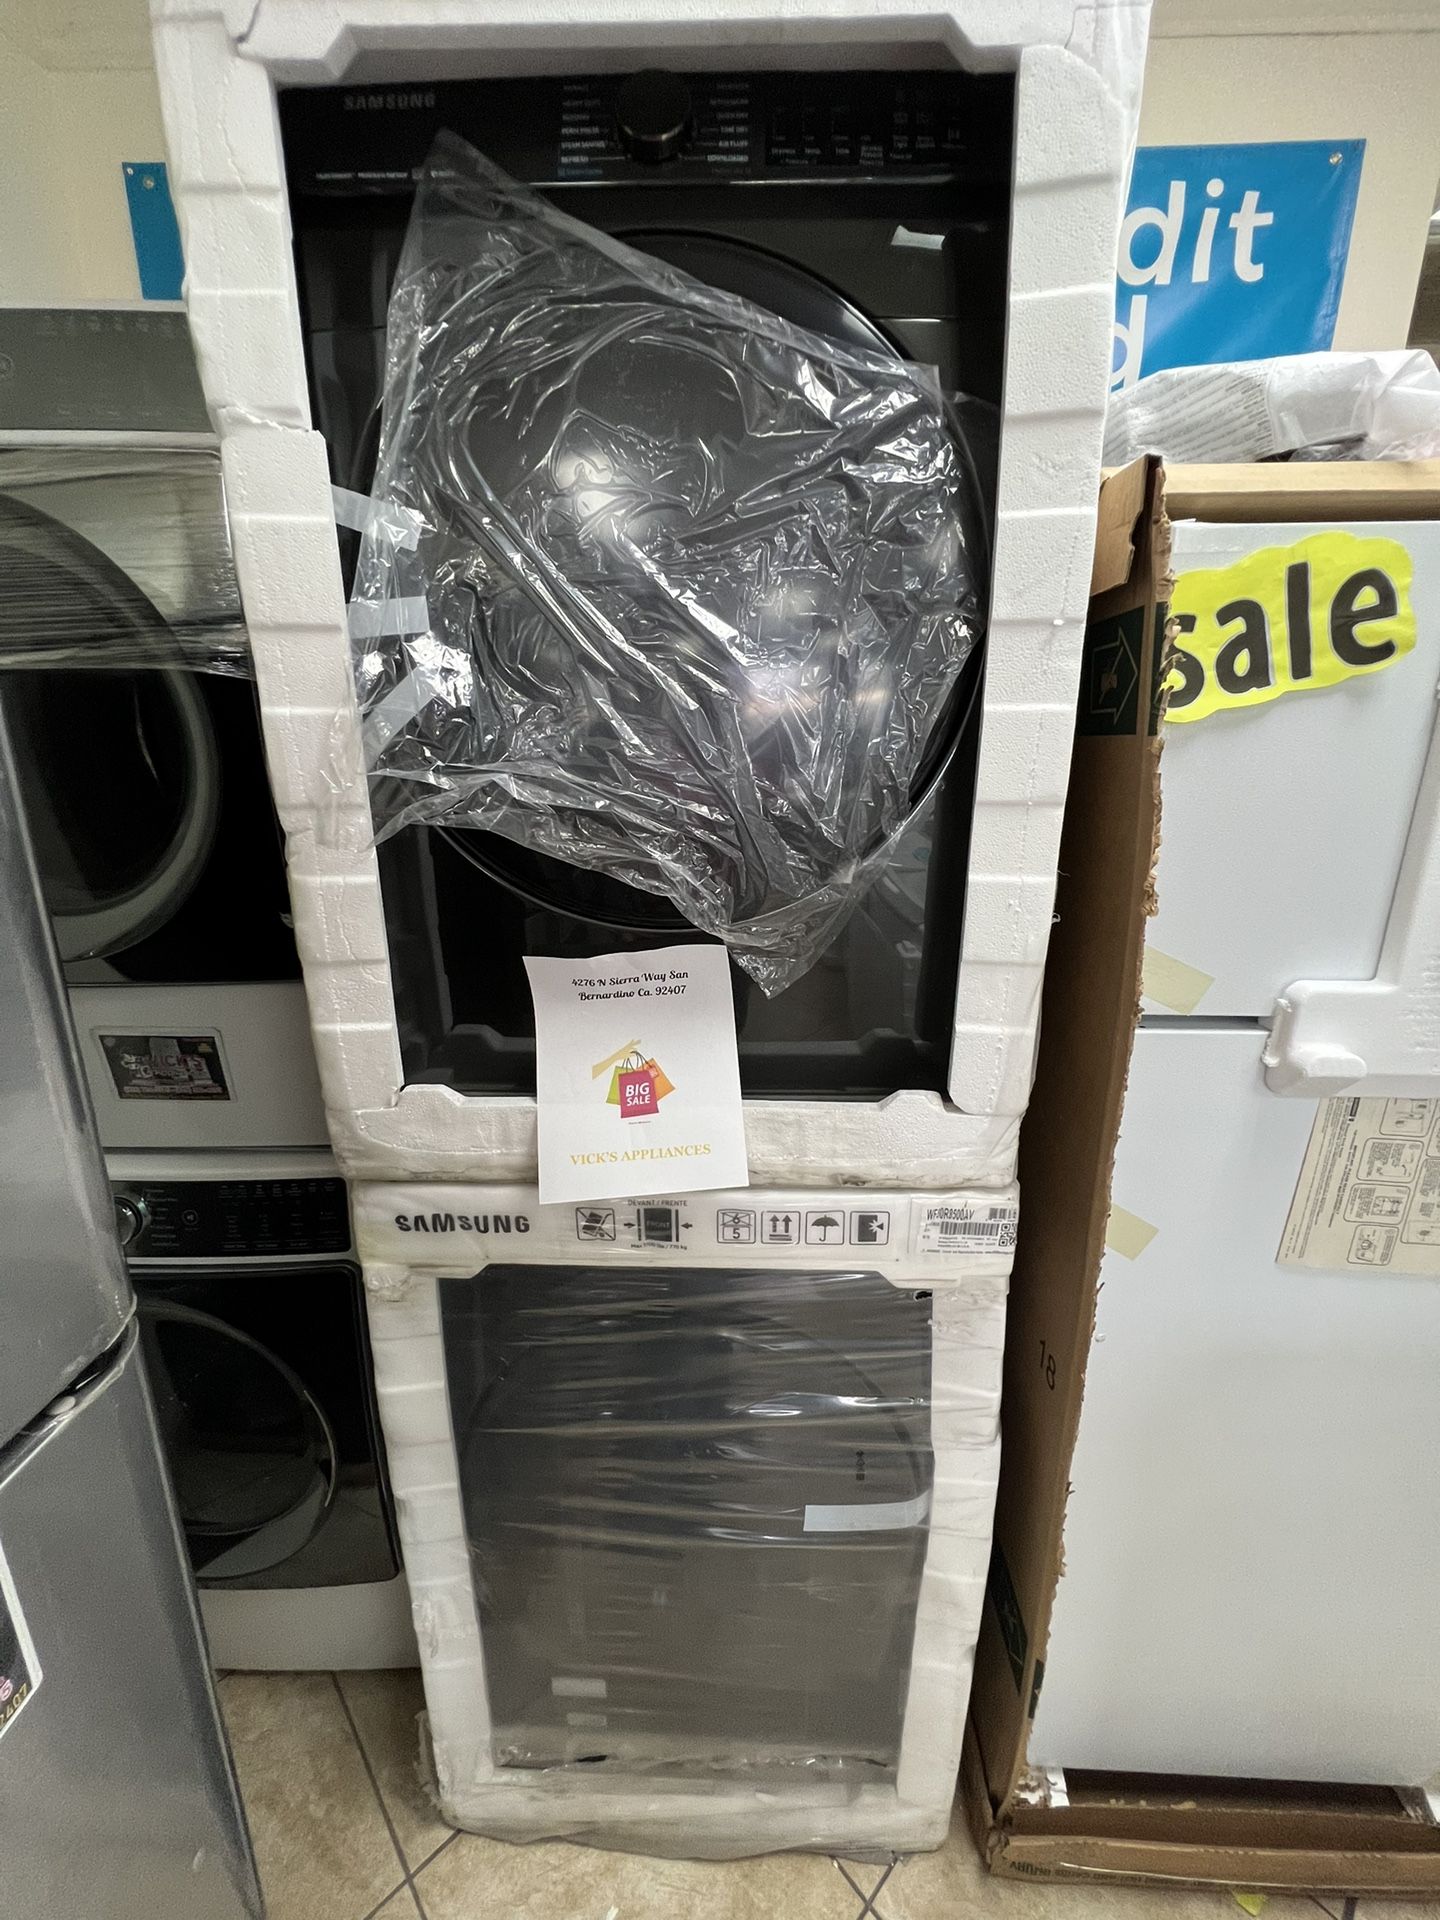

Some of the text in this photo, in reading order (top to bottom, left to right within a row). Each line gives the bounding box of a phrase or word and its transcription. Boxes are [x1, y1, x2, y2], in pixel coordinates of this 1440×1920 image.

[343, 92, 436, 110] SAMSUNG
[1164, 560, 1399, 709] sale
[571, 978, 596, 987] 4276
[609, 976, 640, 986] Sierra
[641, 972, 667, 982] Way
[669, 970, 689, 980] San
[578, 985, 687, 1001] Bernardino Ca. 92407
[625, 1082, 651, 1098] BIG
[626, 1094, 651, 1107] SALE
[570, 1143, 712, 1166] VICK'S APPLIANCES
[394, 1213, 531, 1235] SAMSUNG
[732, 1227, 741, 1240] 5
